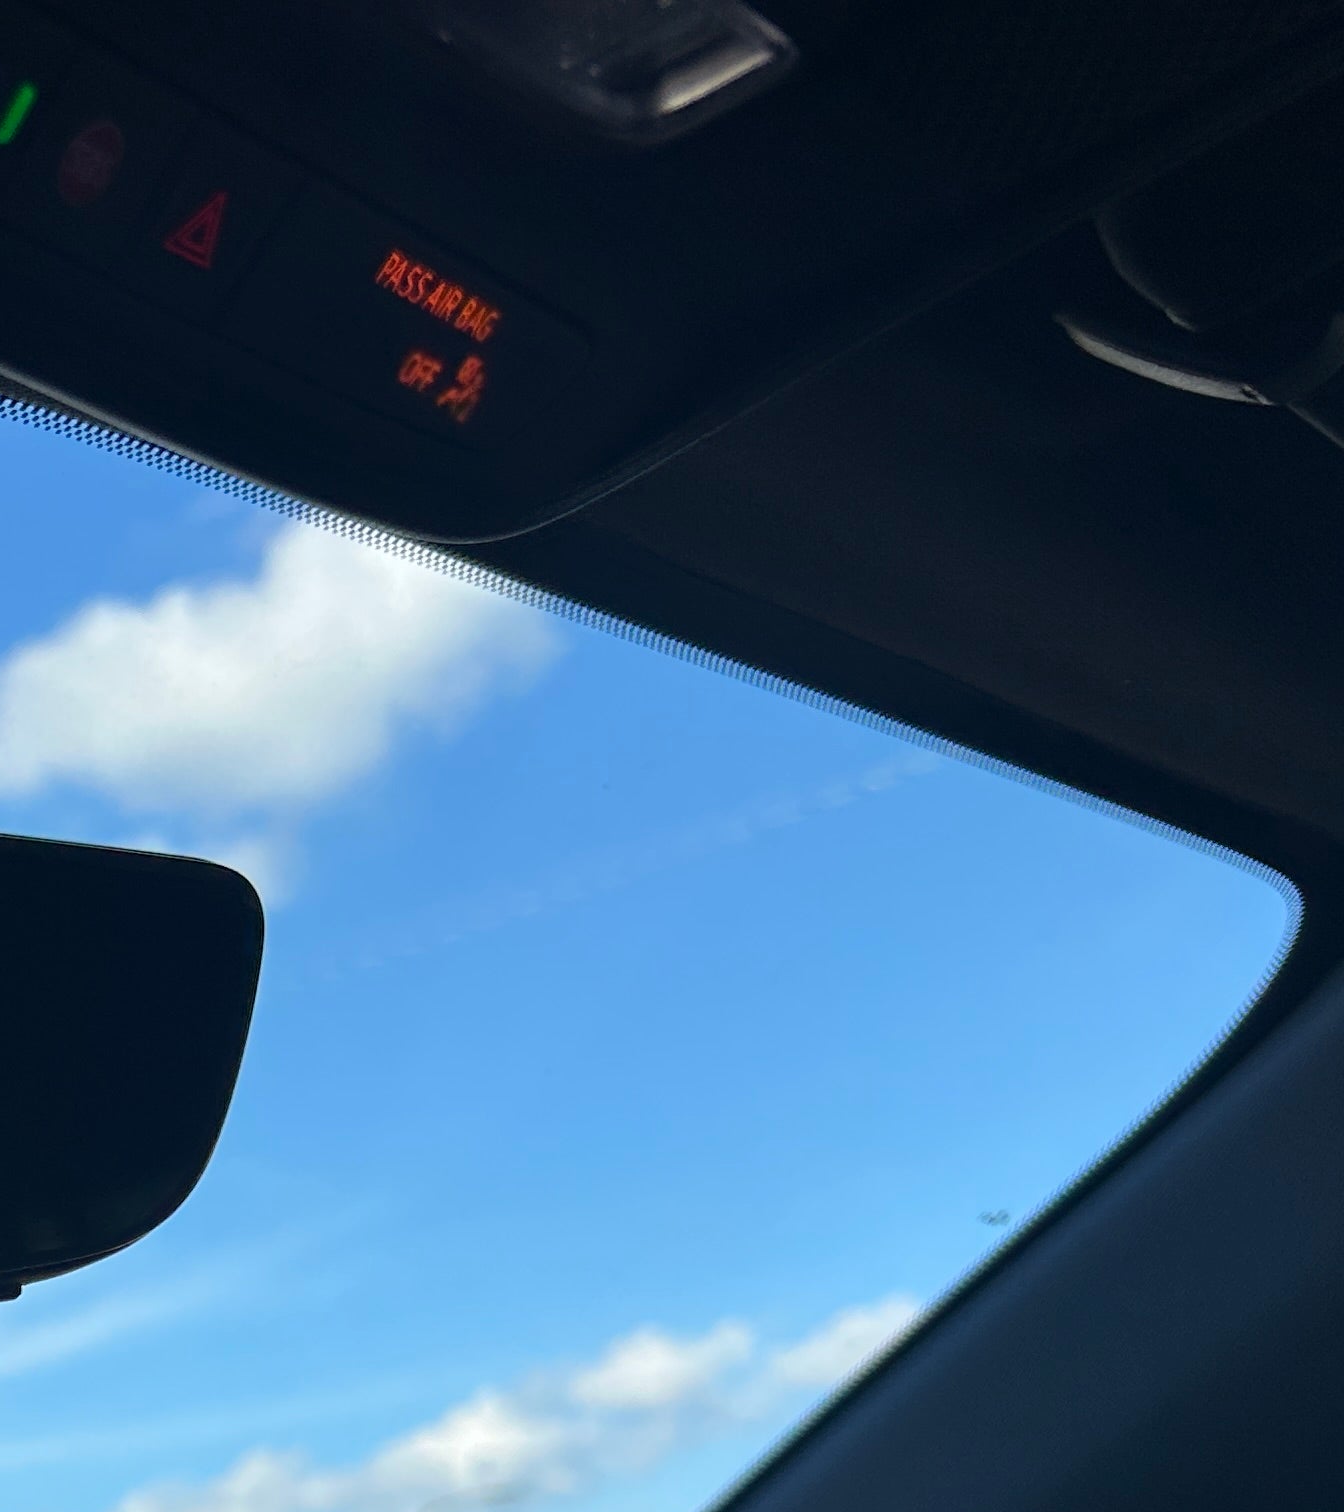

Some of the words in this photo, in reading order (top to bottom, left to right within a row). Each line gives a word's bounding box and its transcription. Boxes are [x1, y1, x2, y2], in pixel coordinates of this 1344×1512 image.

[376, 251, 433, 303] PASS
[423, 282, 463, 321] AIR
[455, 298, 499, 341] BAG
[399, 353, 442, 390] OFF
